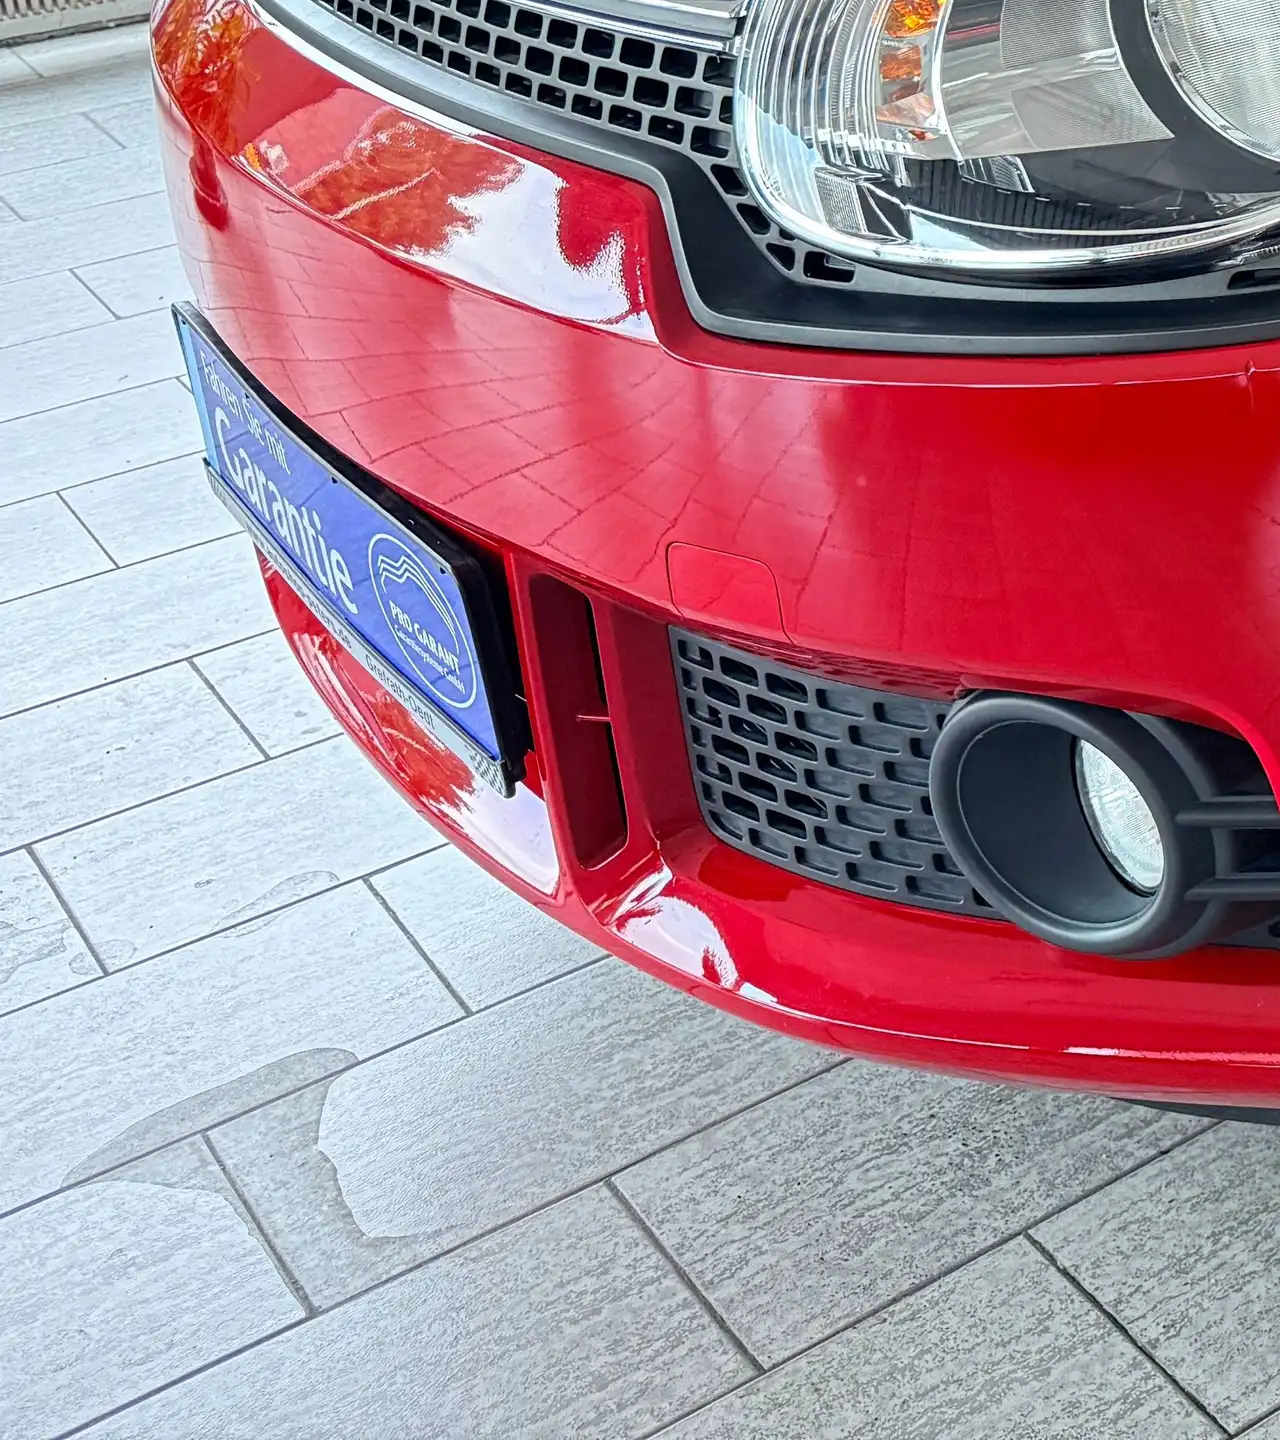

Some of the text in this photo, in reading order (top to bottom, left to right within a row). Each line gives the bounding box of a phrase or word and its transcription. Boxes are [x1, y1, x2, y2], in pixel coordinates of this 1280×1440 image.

[201, 349, 291, 476] Fahren Sie mit
[214, 406, 359, 615] Garantie
[389, 600, 461, 676] PRO GARANT
[366, 653, 436, 731] Grefrath-Oedt
